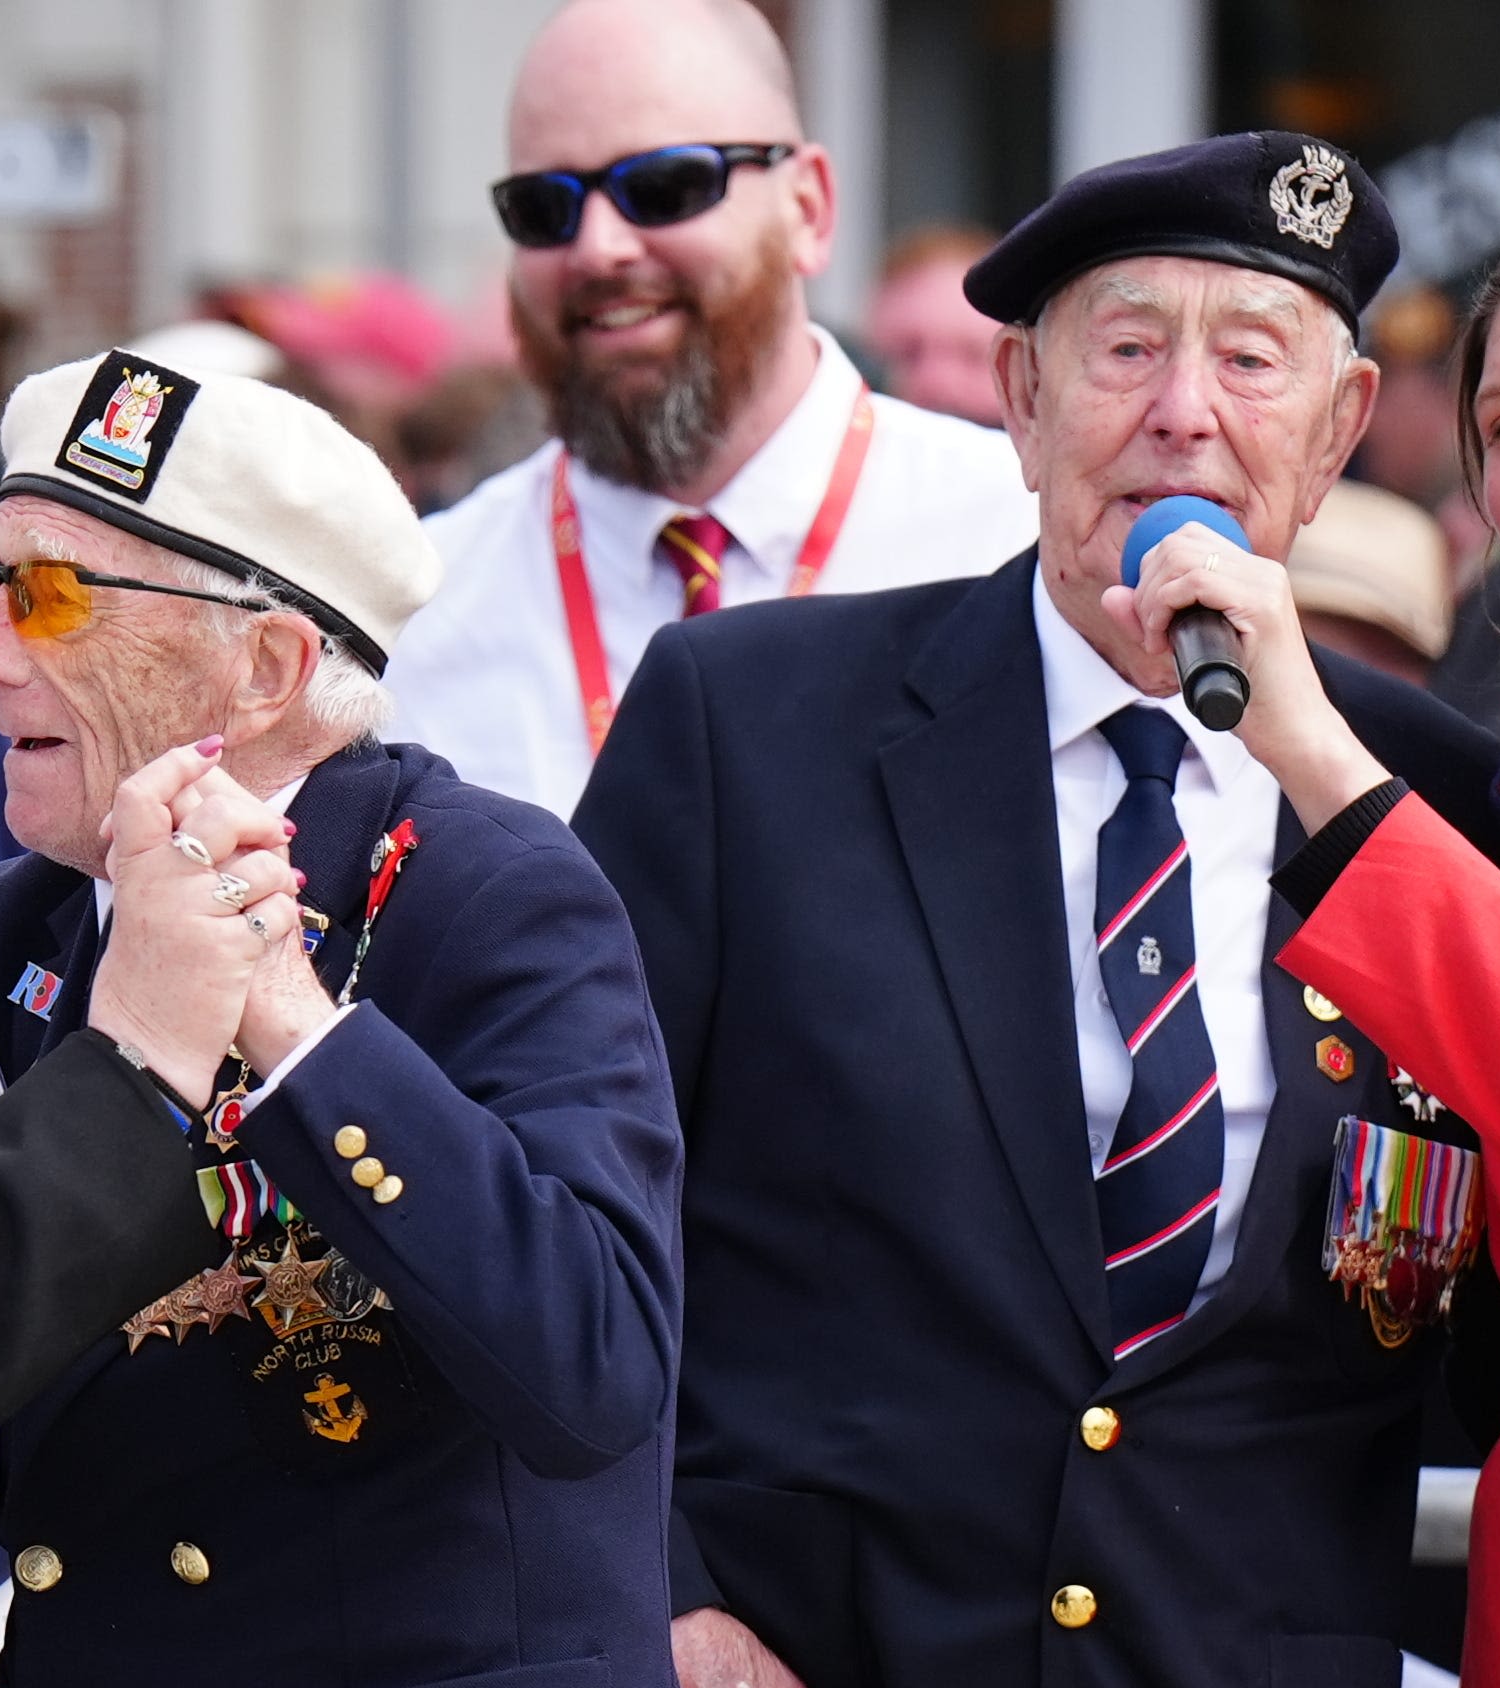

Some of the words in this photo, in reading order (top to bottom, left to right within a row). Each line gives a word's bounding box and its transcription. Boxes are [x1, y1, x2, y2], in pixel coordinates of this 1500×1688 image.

[252, 1329, 315, 1382] NORTH
[321, 1324, 382, 1346] RUSSIA
[295, 1343, 341, 1370] CLUB
